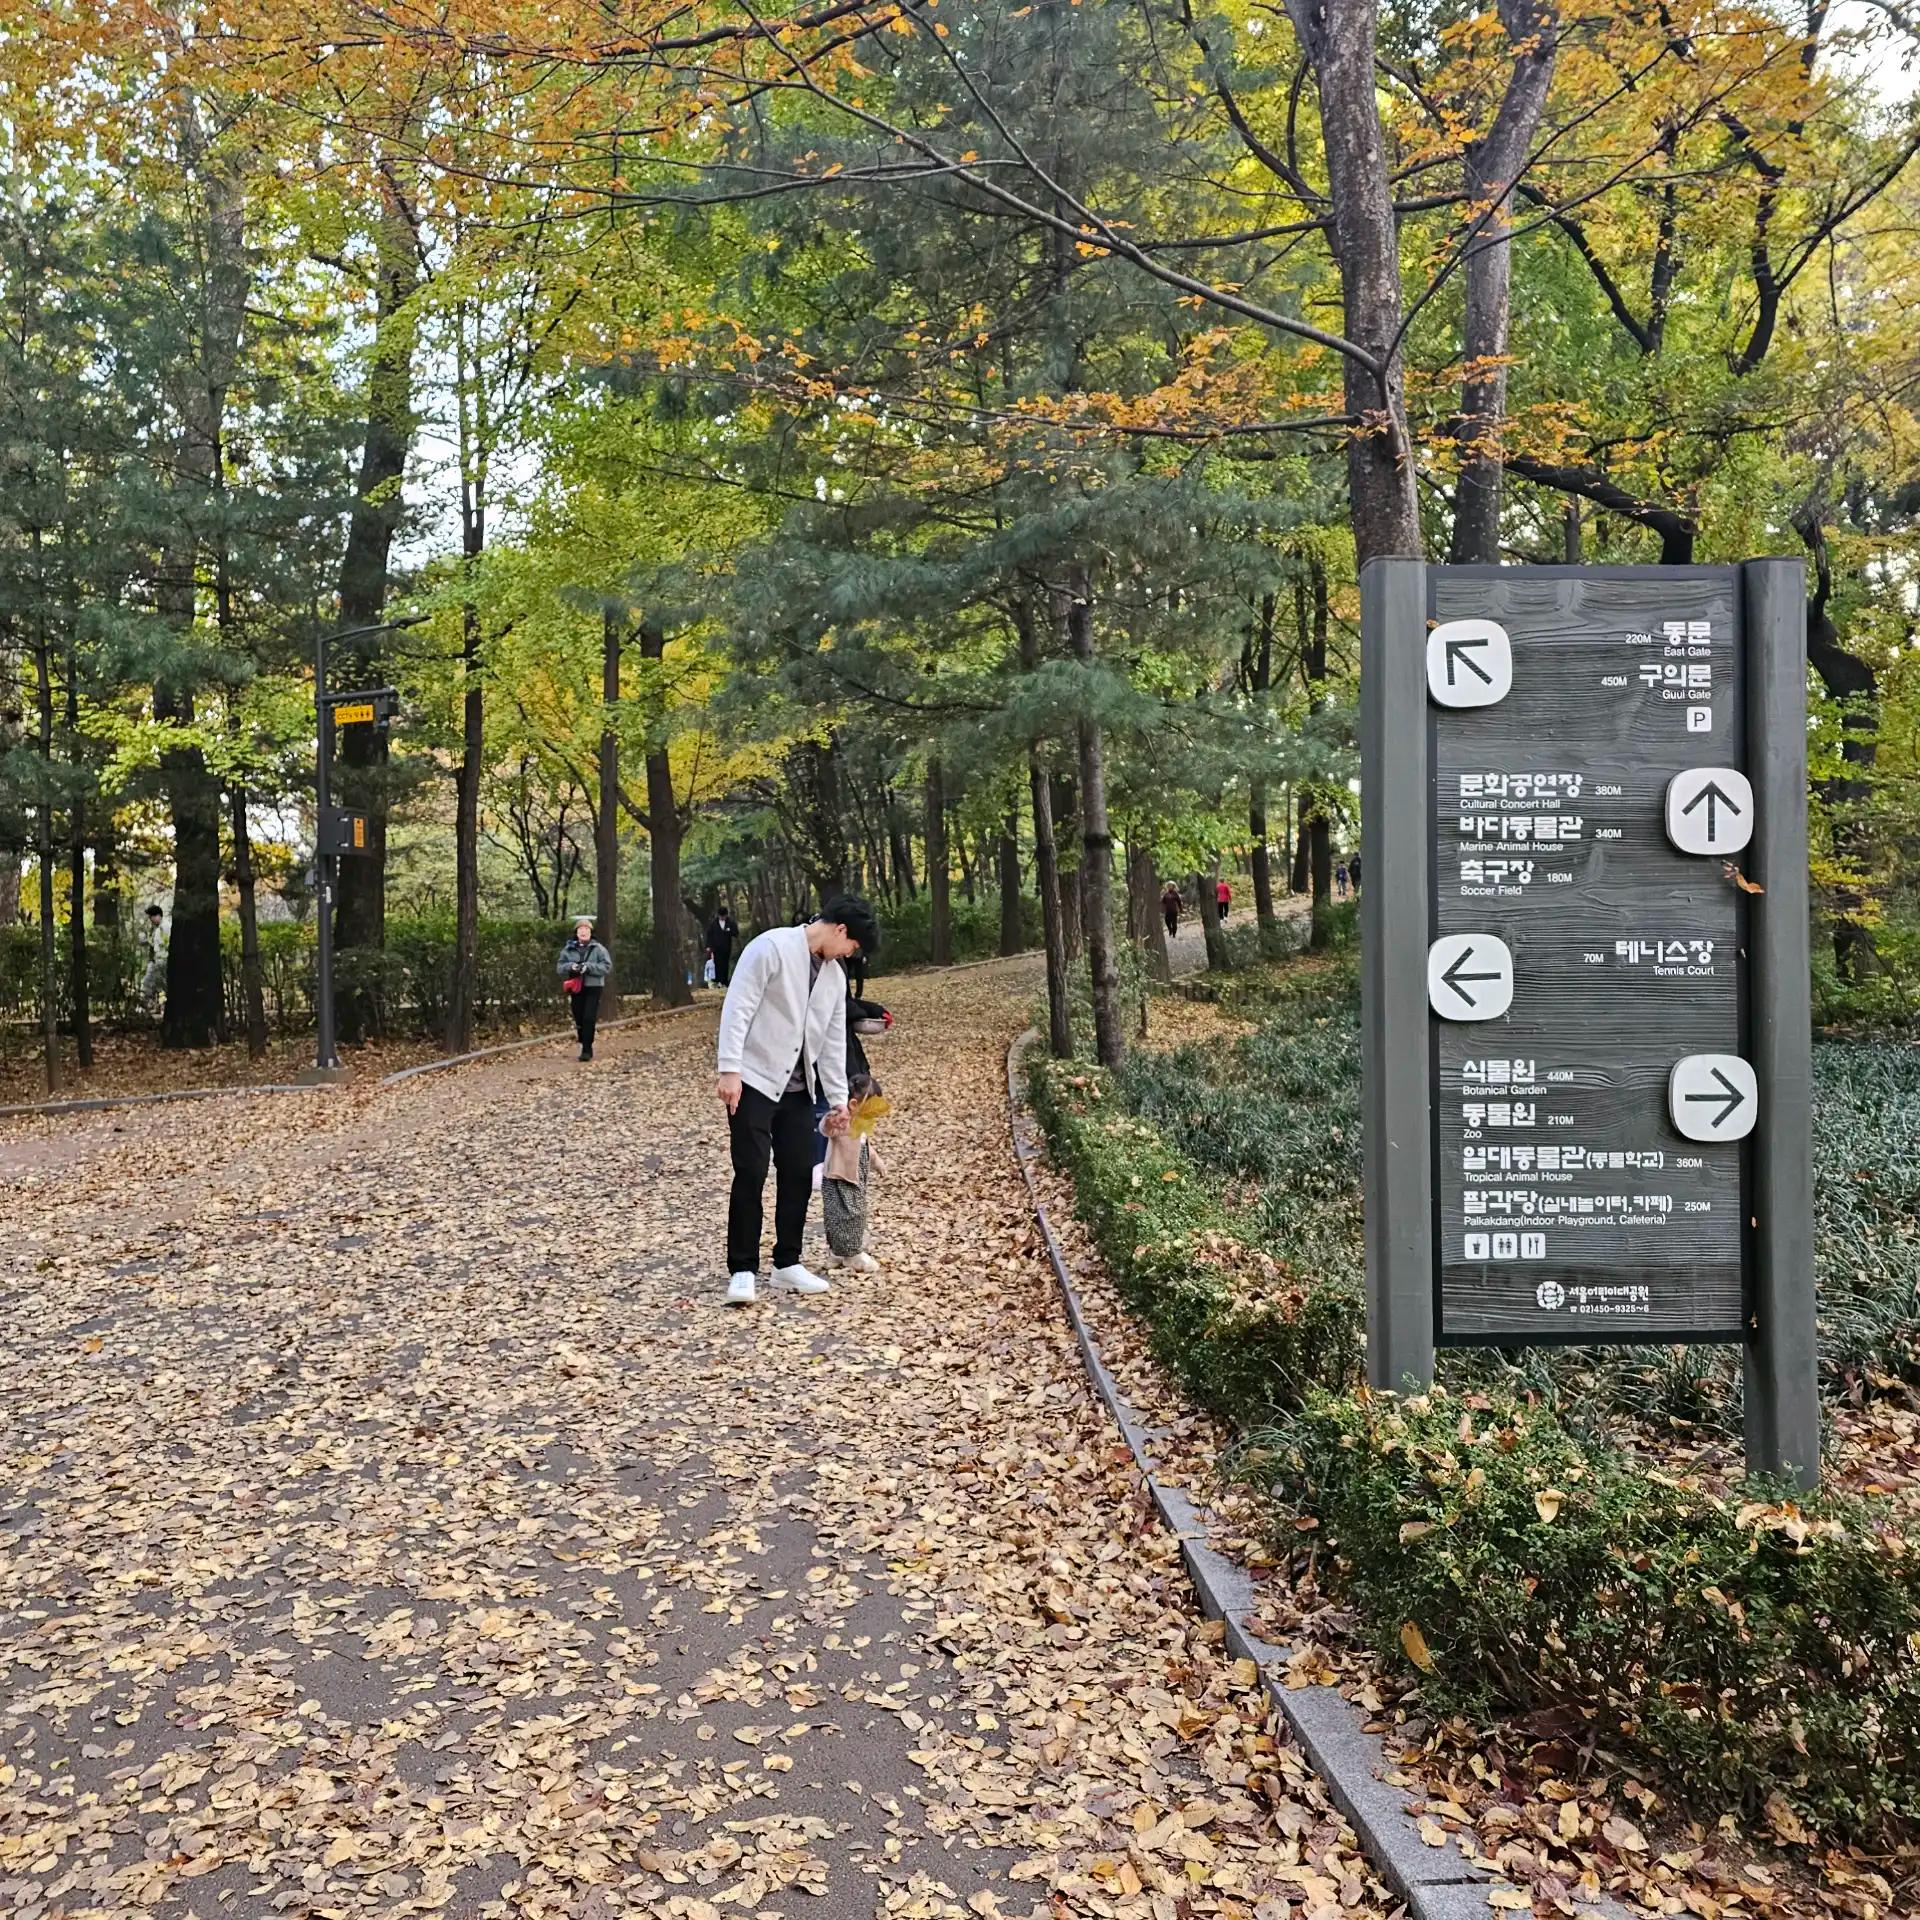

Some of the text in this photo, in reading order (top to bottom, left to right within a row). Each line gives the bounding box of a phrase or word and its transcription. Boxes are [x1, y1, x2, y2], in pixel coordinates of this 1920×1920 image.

[1625, 621, 1711, 646] 220M 동문
[1664, 647, 1711, 657] East Gate
[1601, 664, 1711, 688] 450M 구의문
[1662, 689, 1711, 700] Guui Gate
[1460, 772, 1622, 798] 문화공연장 380M
[1460, 799, 1561, 809] Cultural Concert Hall
[1460, 816, 1622, 840] 바다동물관 340M
[1460, 842, 1564, 852] Marine Animal House
[1460, 859, 1573, 884] 축구장 180M
[1460, 886, 1522, 896] Soccer Field
[1583, 940, 1715, 964] 70M 테니스장
[1653, 966, 1715, 976] Tennis Court
[1462, 1058, 1574, 1083] 식물원 440M
[1462, 1085, 1548, 1096] Botanical Garden
[1462, 1102, 1574, 1128] 동물원 210M
[1463, 1129, 1482, 1139] Zoo
[1676, 1158, 1703, 1168] 360M
[1463, 1172, 1574, 1183] Tropical Animal House
[1684, 1201, 1711, 1212] 250M
[1558, 1215, 1616, 1227] Playground,
[1619, 1213, 1667, 1226] Cafeteria)
[1568, 1285, 1649, 1304] 서울어린이대공원
